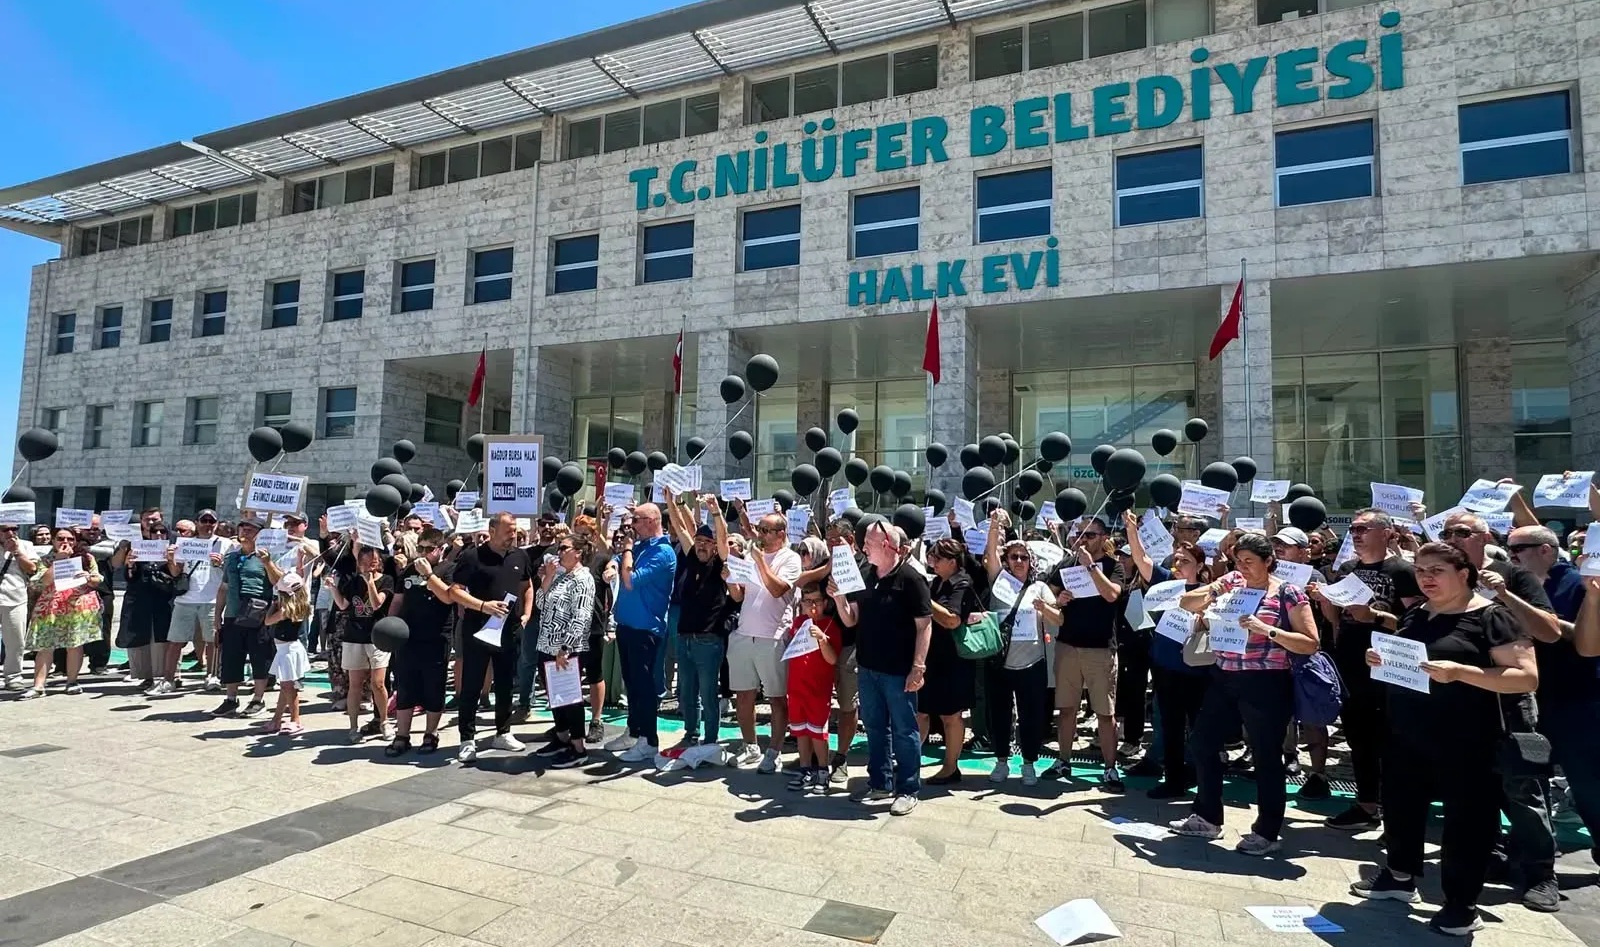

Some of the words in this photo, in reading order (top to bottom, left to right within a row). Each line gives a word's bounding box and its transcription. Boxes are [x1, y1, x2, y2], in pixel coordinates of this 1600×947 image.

[970, 12, 1405, 158] BELEDİYESİ
[848, 259, 967, 307] HALK
[983, 236, 1060, 294] EVİ
[490, 448, 508, 461] MAĞDUR
[508, 449, 522, 461] BURSA
[523, 449, 537, 461] HALKI
[251, 477, 273, 489] PARAMIZI
[273, 480, 289, 491] VERDİK
[289, 482, 300, 491] AMA
[517, 486, 536, 499] NEREDE?
